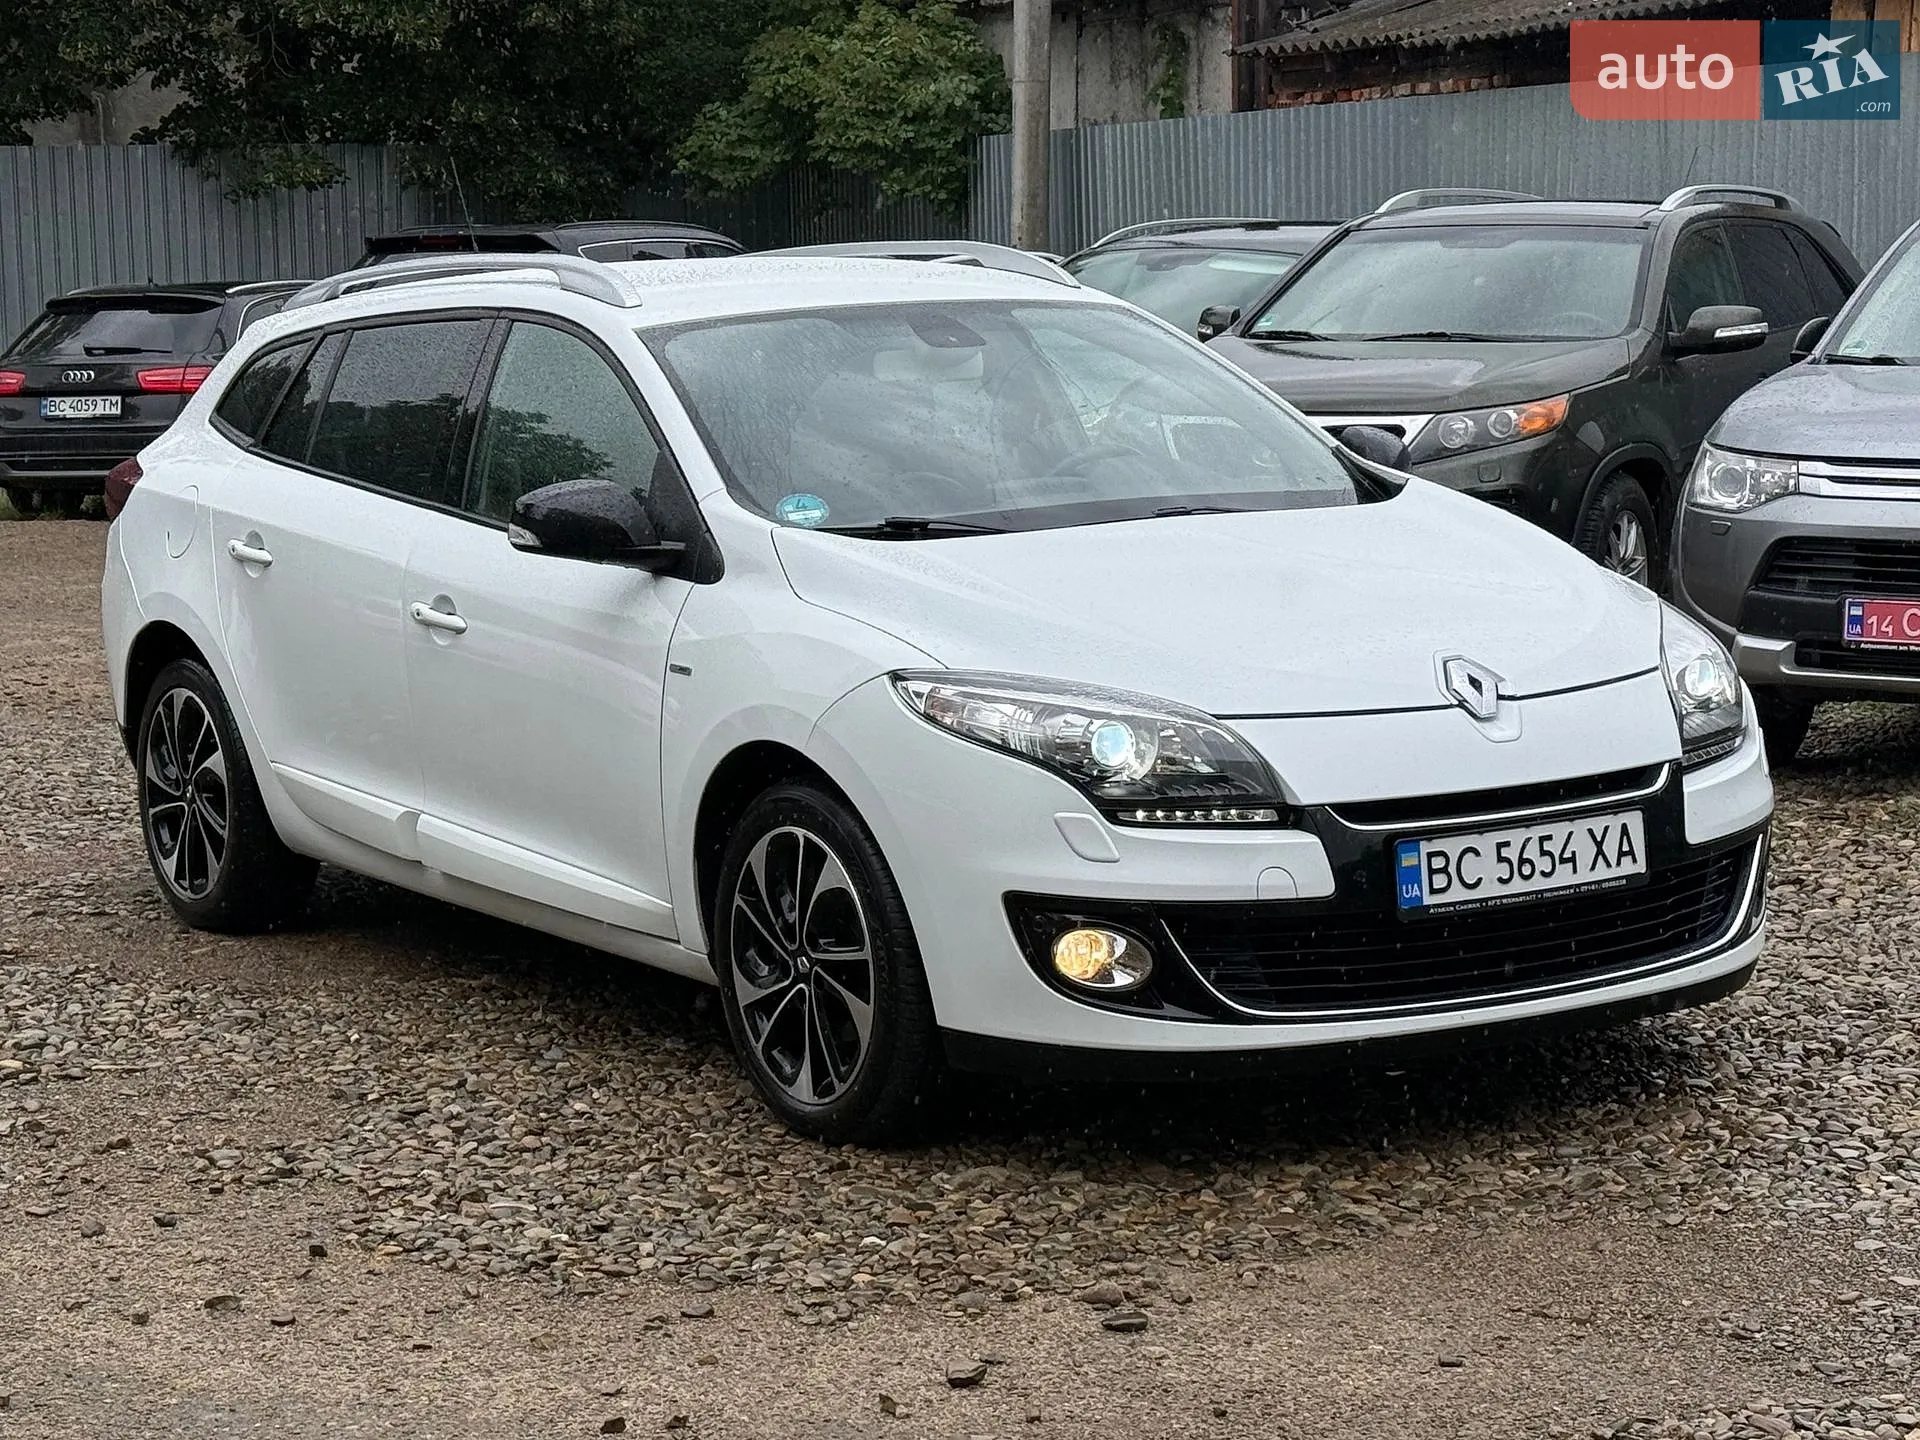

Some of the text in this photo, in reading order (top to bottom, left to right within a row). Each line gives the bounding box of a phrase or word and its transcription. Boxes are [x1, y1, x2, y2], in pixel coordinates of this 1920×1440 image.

[48, 400, 66, 413] BC
[68, 399, 98, 412] 4059
[100, 399, 119, 412] TM
[1849, 624, 1861, 634] UA
[1867, 615, 1894, 637] 14
[1426, 822, 1638, 895] BC 5654 XA
[1402, 883, 1421, 899] UA
